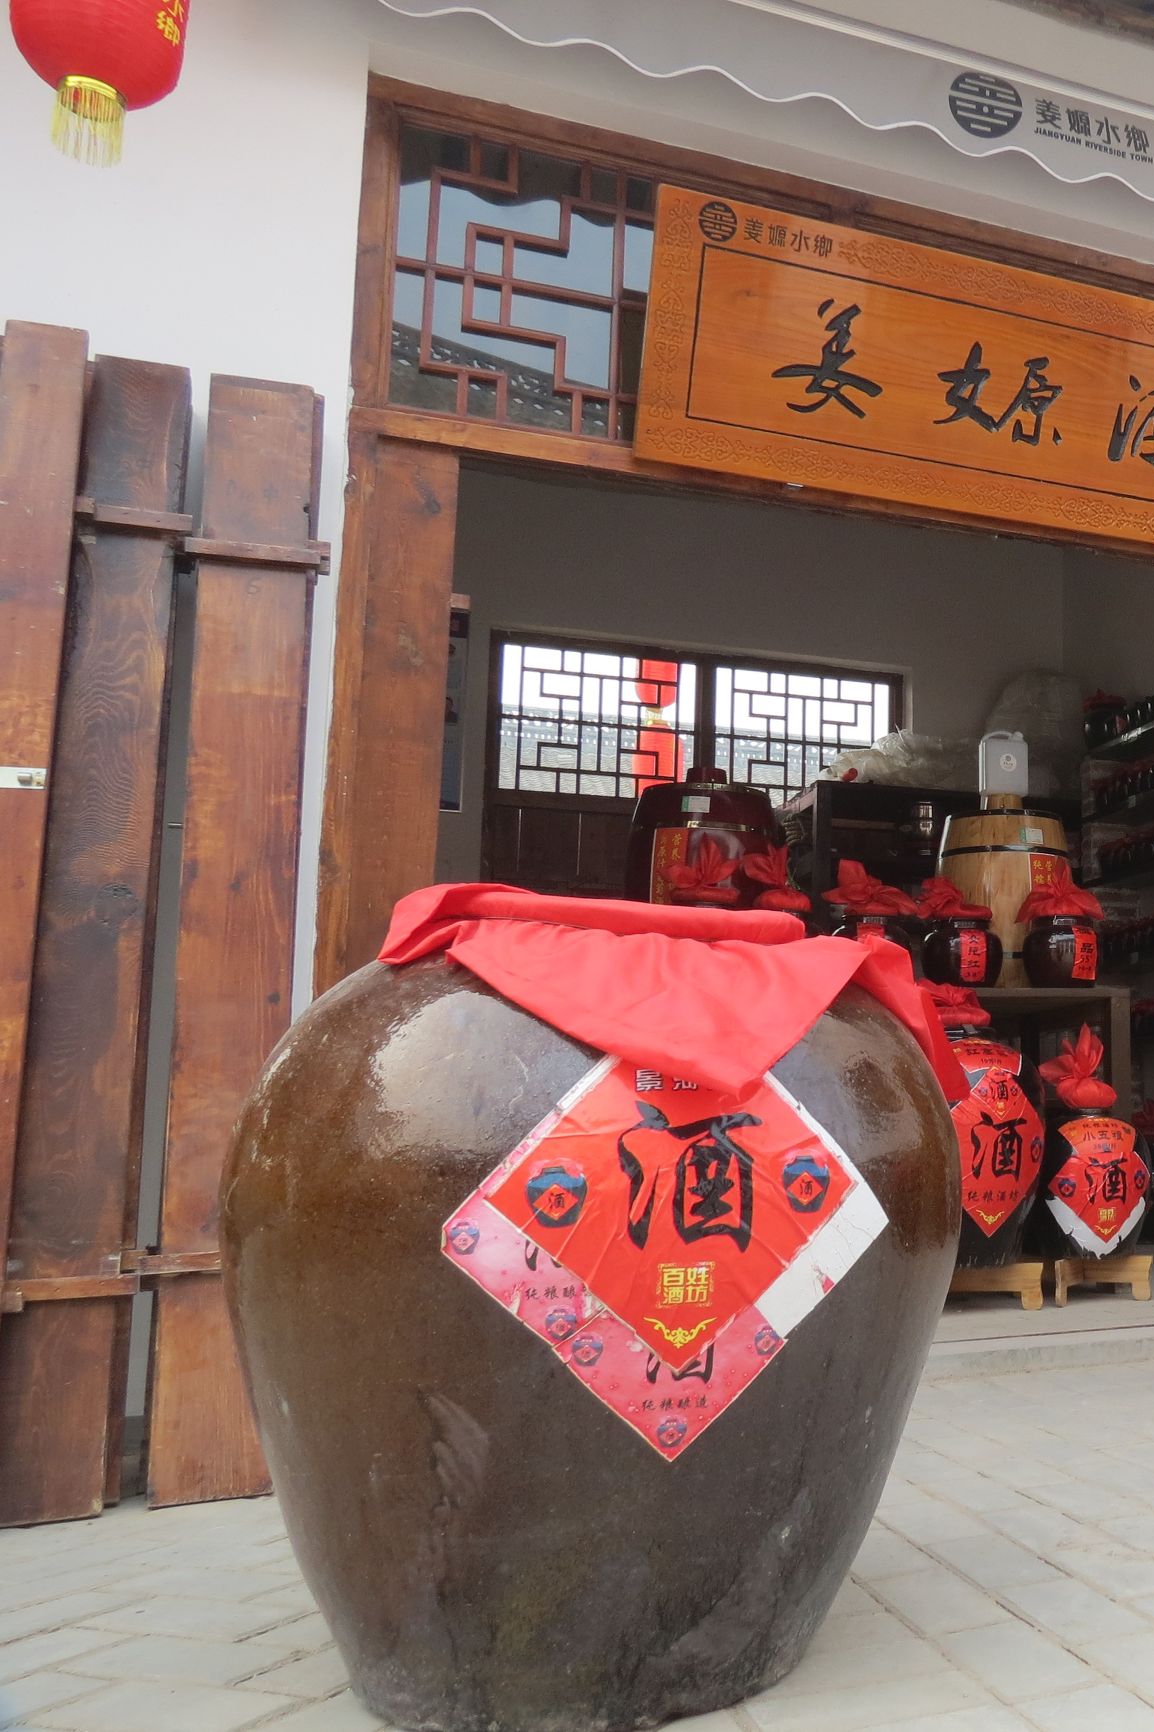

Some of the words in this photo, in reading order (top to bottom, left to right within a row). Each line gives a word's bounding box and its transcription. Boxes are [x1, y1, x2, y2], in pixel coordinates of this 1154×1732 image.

[1034, 126, 1082, 146] JIANGYUAN
[1085, 140, 1127, 159] RIVERSIDE
[1130, 152, 1154, 164] TOWN
[971, 1111, 1027, 1182] 酒
[617, 1100, 763, 1254] 酒
[1084, 1156, 1128, 1205] 酒
